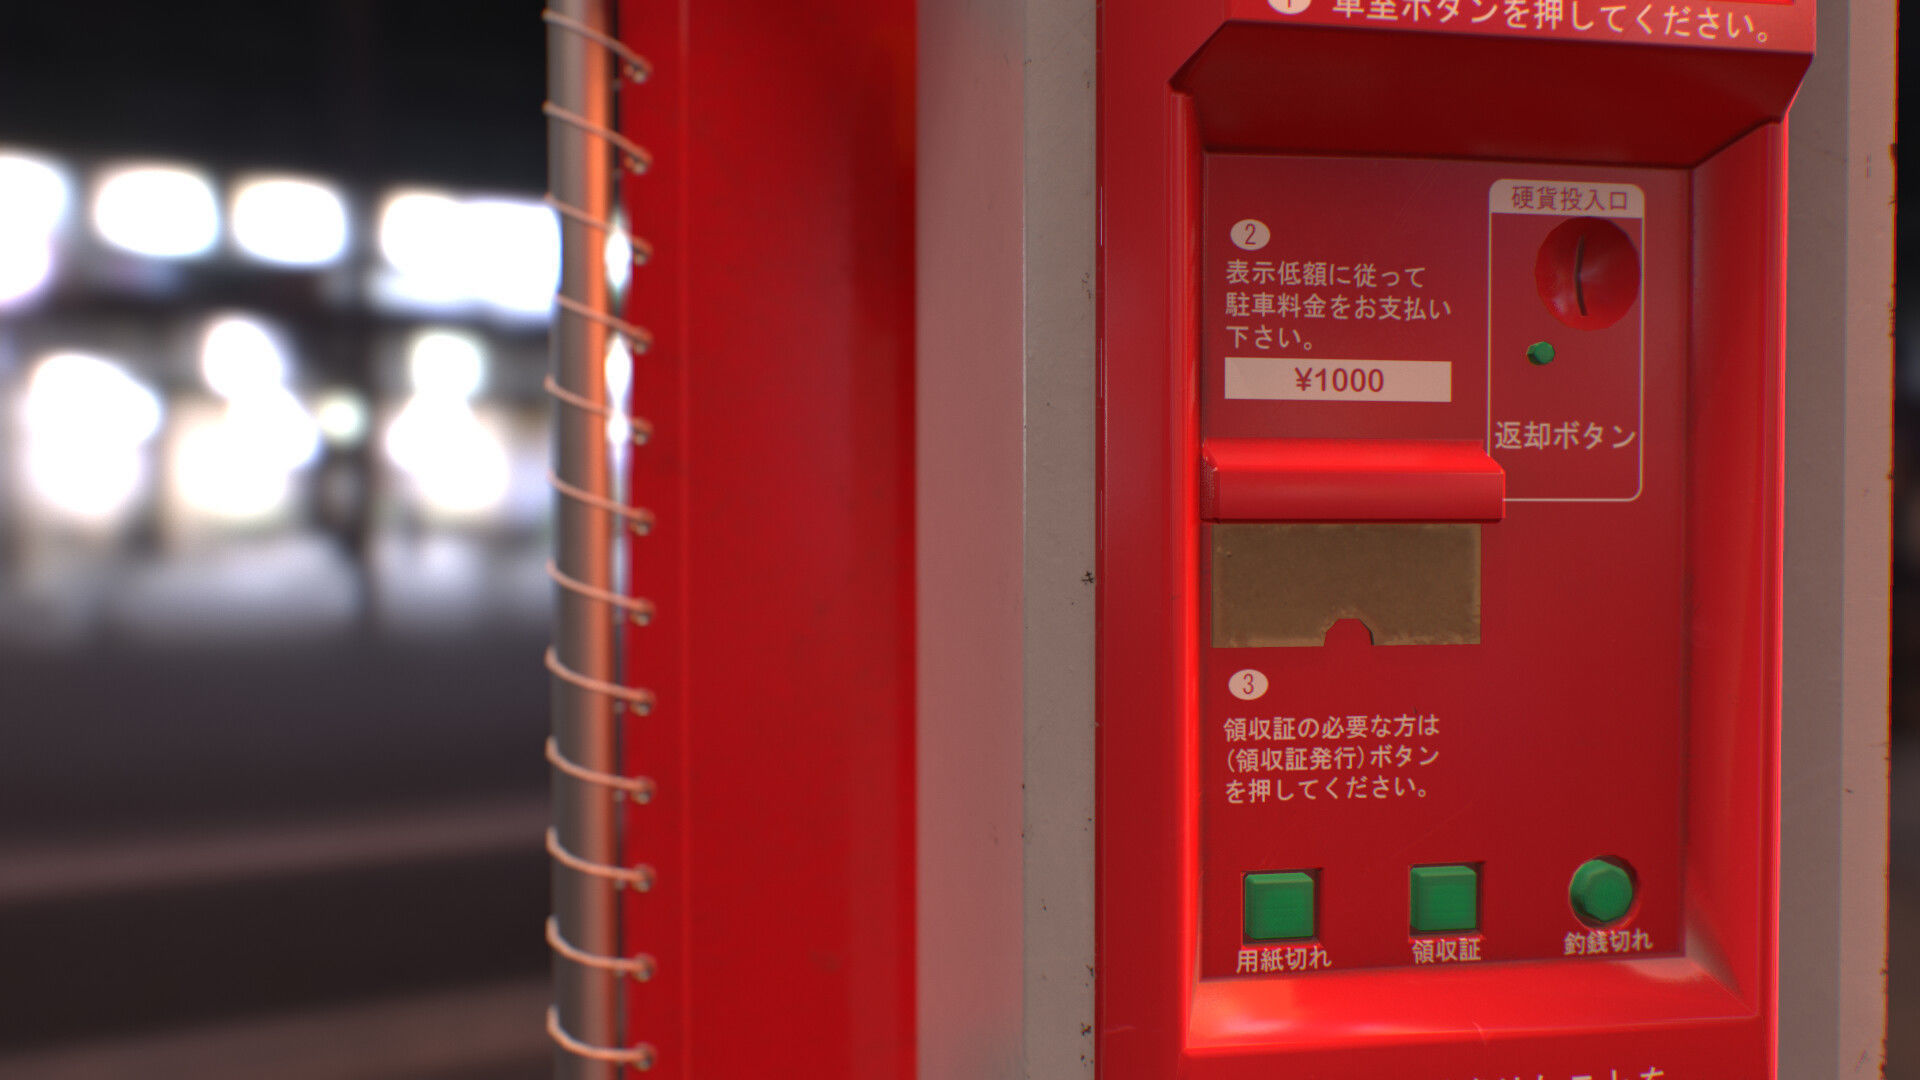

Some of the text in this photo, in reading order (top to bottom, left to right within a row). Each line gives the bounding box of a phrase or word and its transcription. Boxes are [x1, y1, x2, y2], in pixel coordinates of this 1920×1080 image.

[1511, 185, 1628, 211] 硬貨投入口
[1244, 223, 1256, 245] 2
[1226, 258, 1426, 288] 表示低額に従って
[1225, 292, 1451, 321] 駐車料金をお支払い
[1226, 324, 1312, 351] 下さい。
[1294, 367, 1384, 392] ¥1000
[1495, 420, 1636, 450] 返却ボタン
[1242, 673, 1254, 695] 3
[1223, 713, 1440, 742] 領収証の必要な方は
[1226, 775, 1427, 804] を押してください。
[1411, 938, 1482, 965] 領収証
[1563, 928, 1654, 956] 釣銭切れ
[1236, 945, 1332, 974] 用紙切れ
